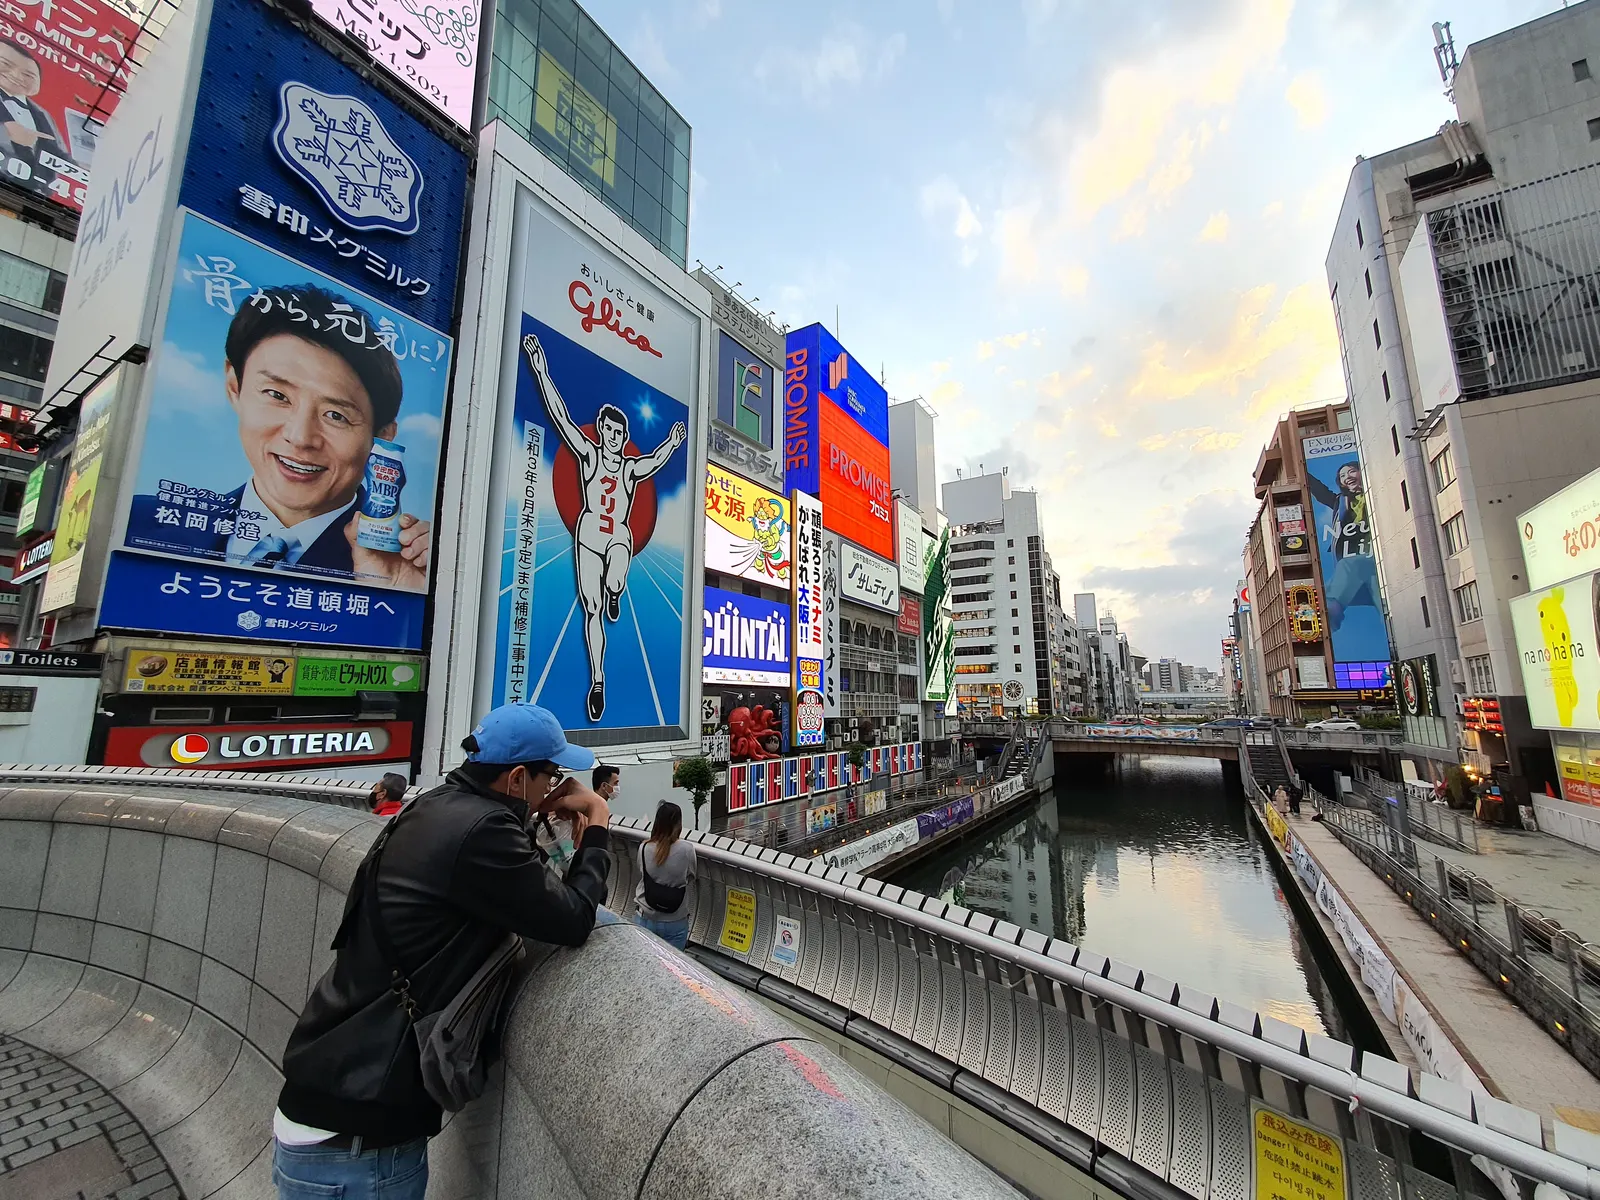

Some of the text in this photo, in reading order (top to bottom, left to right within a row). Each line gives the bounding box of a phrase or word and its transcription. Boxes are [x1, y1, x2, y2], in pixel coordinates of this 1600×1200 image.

[406, 64, 449, 107] 2021
[73, 115, 165, 279] FANCL
[239, 184, 431, 297] 雪印メグミルク
[580, 262, 656, 324] おいしさと健康
[568, 280, 663, 359] Glico
[786, 347, 809, 472] PROMISE
[828, 442, 890, 508] PROMISE
[157, 492, 269, 522] 健康推進アンバサダー
[159, 479, 238, 505] 雪印メグミルク
[599, 475, 619, 535] グリコ
[154, 505, 262, 542] 松岡修造
[869, 499, 890, 523] プロミス
[160, 571, 396, 617] ようこそ道頓堀へ
[856, 572, 887, 598] サムティ
[264, 617, 339, 633] 雪印メグミルク
[18, 653, 79, 667] Toilets
[174, 657, 261, 671] 店舗情報館
[339, 663, 387, 685] ピタットハウス
[219, 731, 375, 759] LOTTERIA
[1257, 1130, 1291, 1152] Danger!
